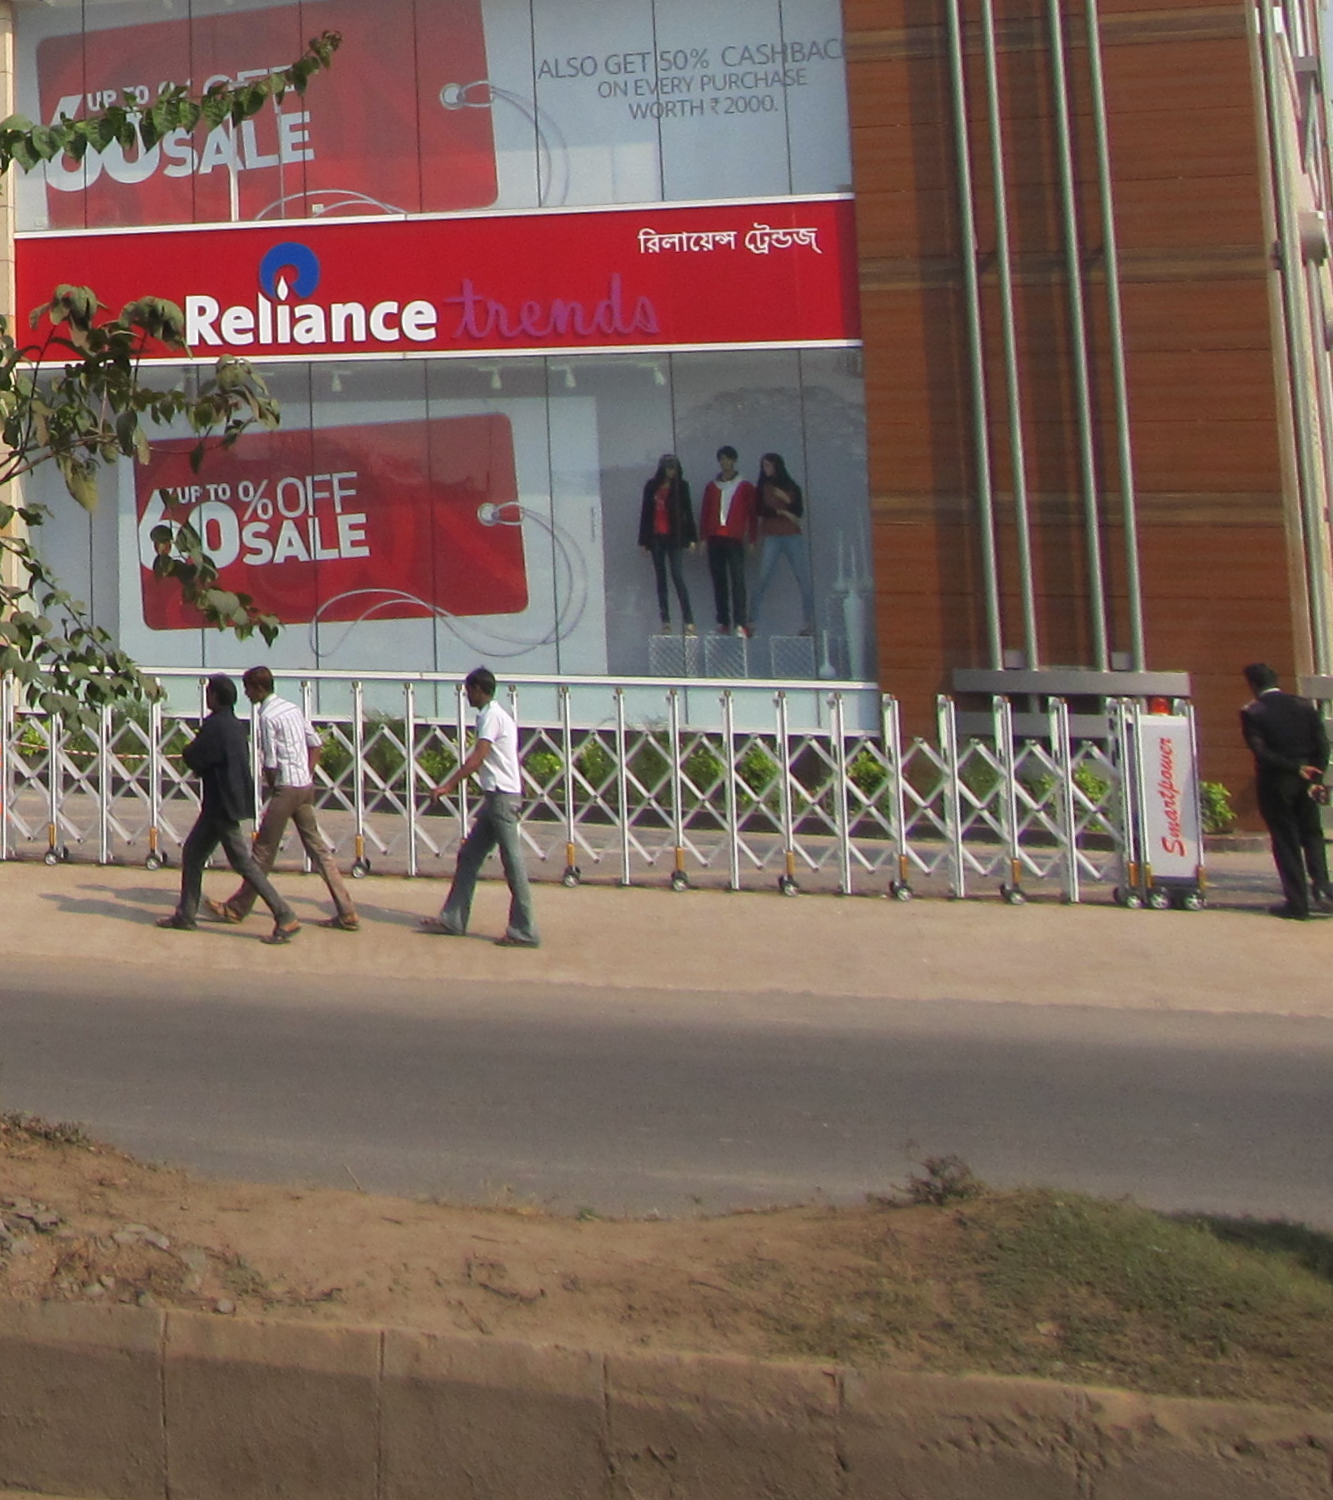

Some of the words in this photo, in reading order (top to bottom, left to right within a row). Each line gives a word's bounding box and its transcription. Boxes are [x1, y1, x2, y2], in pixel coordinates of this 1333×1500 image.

[537, 55, 598, 81] ALSO
[604, 52, 652, 76] GET
[659, 48, 710, 73] 50%
[597, 80, 629, 99] ON
[634, 73, 695, 97] EVERY
[700, 67, 809, 92] PURCHASE
[87, 89, 118, 112] UP
[628, 102, 705, 121] WORTH
[162, 111, 316, 178] SALE
[184, 277, 438, 347] Reliance
[443, 273, 661, 339] trends
[177, 486, 202, 505] UP
[206, 483, 232, 500] TO
[241, 513, 371, 566] SALE
